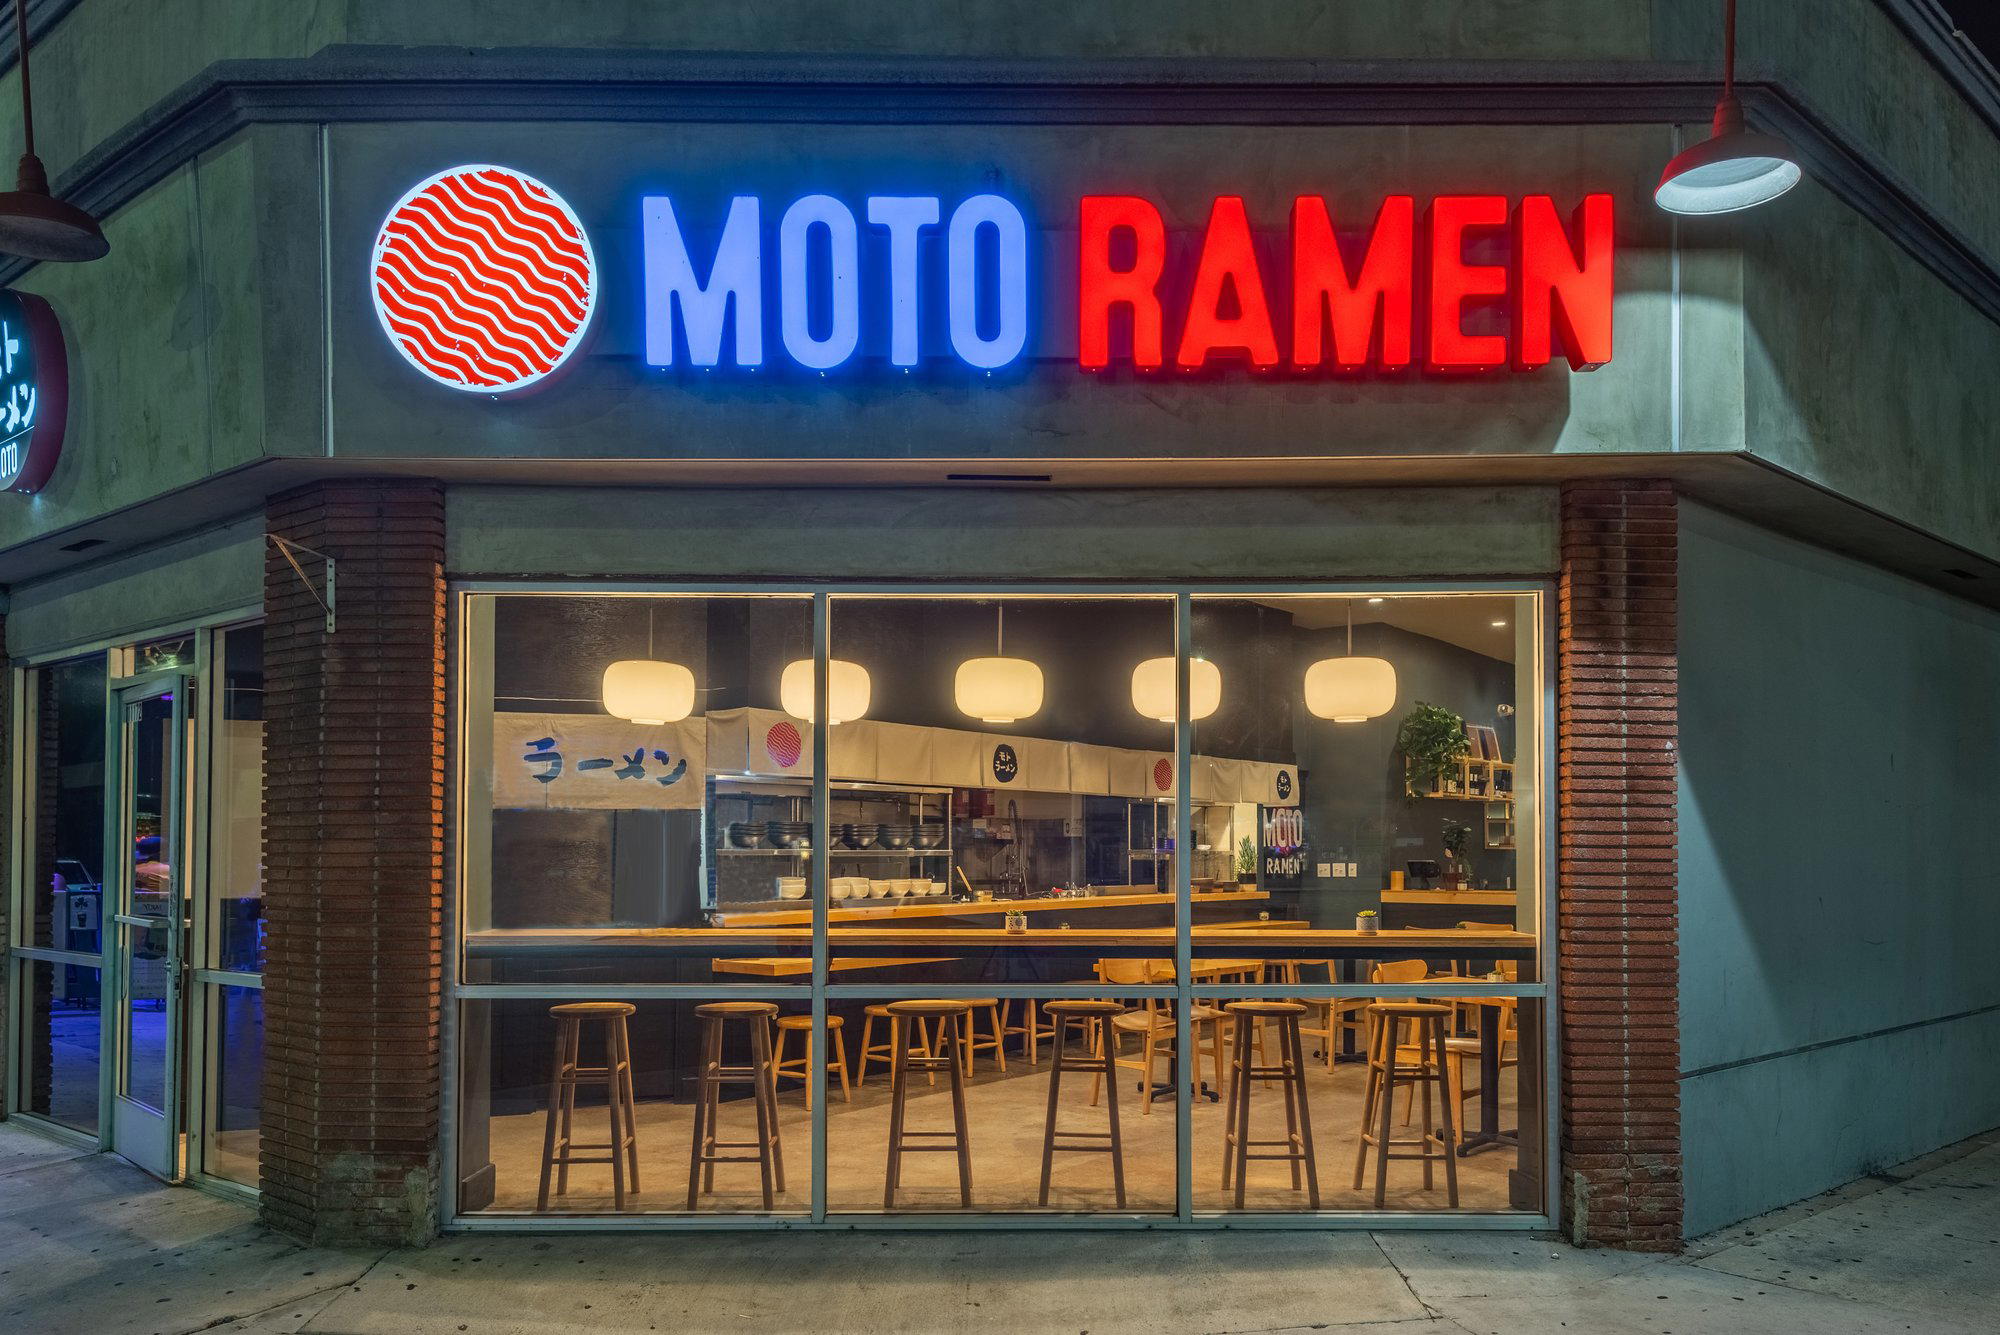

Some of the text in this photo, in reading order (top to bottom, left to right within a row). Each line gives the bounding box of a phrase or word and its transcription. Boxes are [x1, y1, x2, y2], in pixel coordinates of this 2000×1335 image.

[643, 194, 1614, 372] MOTO RAMEN
[0, 320, 19, 377] ト
[0, 442, 18, 479] OTO
[523, 737, 688, 787] ラーメン
[995, 760, 1016, 773] ラーメン
[999, 751, 1011, 762] モト
[1263, 808, 1303, 848] MOTO
[1266, 857, 1301, 875] RAMEN
